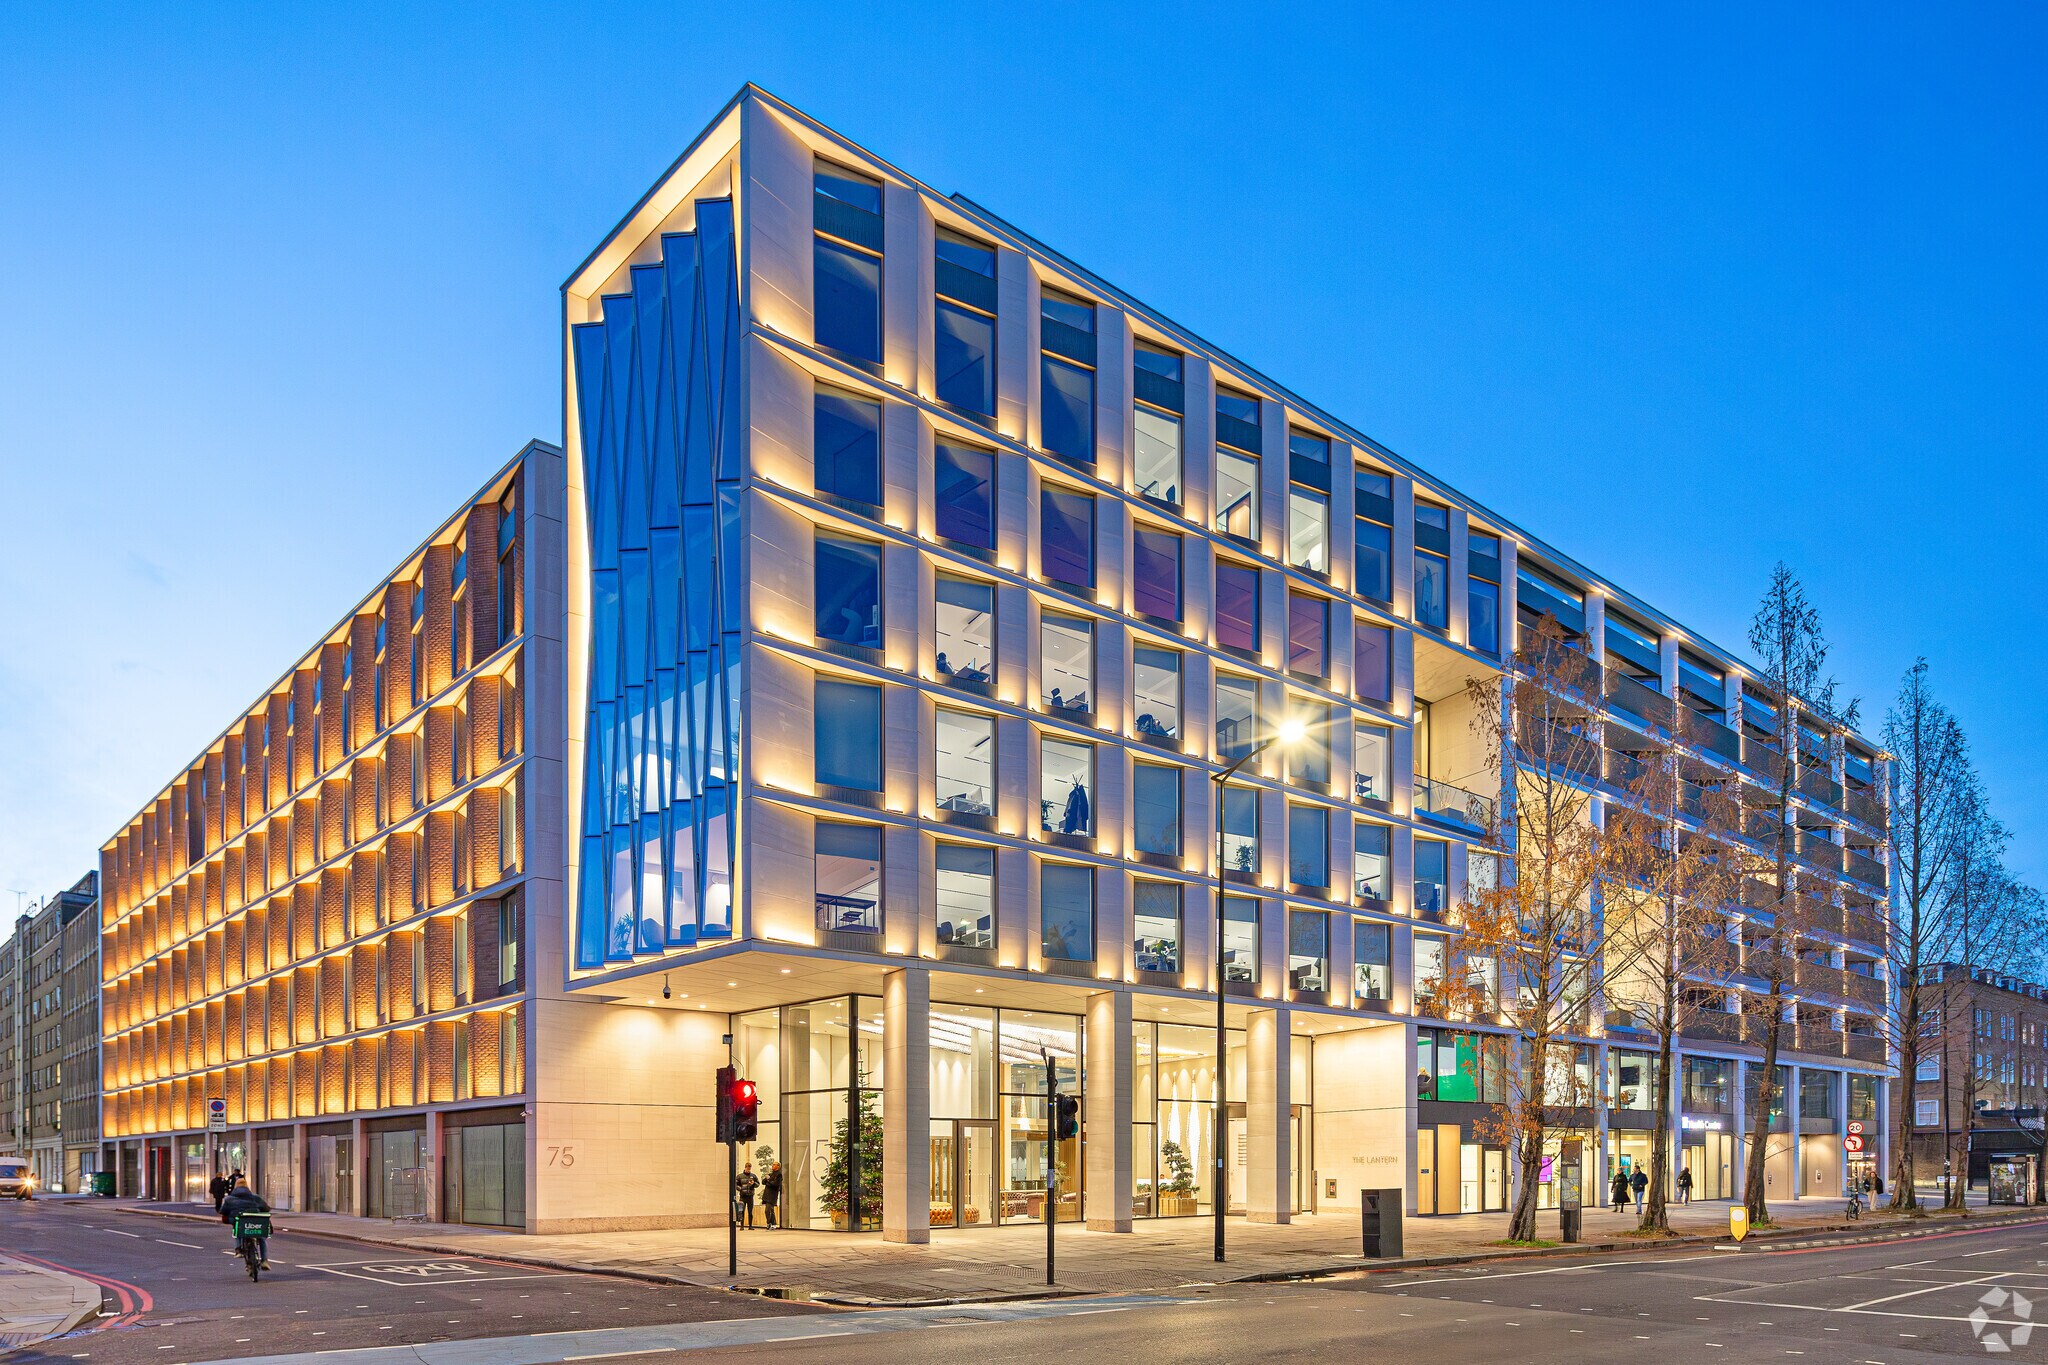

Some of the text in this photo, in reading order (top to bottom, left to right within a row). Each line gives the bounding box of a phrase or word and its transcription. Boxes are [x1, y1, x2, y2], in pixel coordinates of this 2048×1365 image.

[547, 1146, 574, 1167] 75
[1352, 1156, 1398, 1164] THE LANTERN
